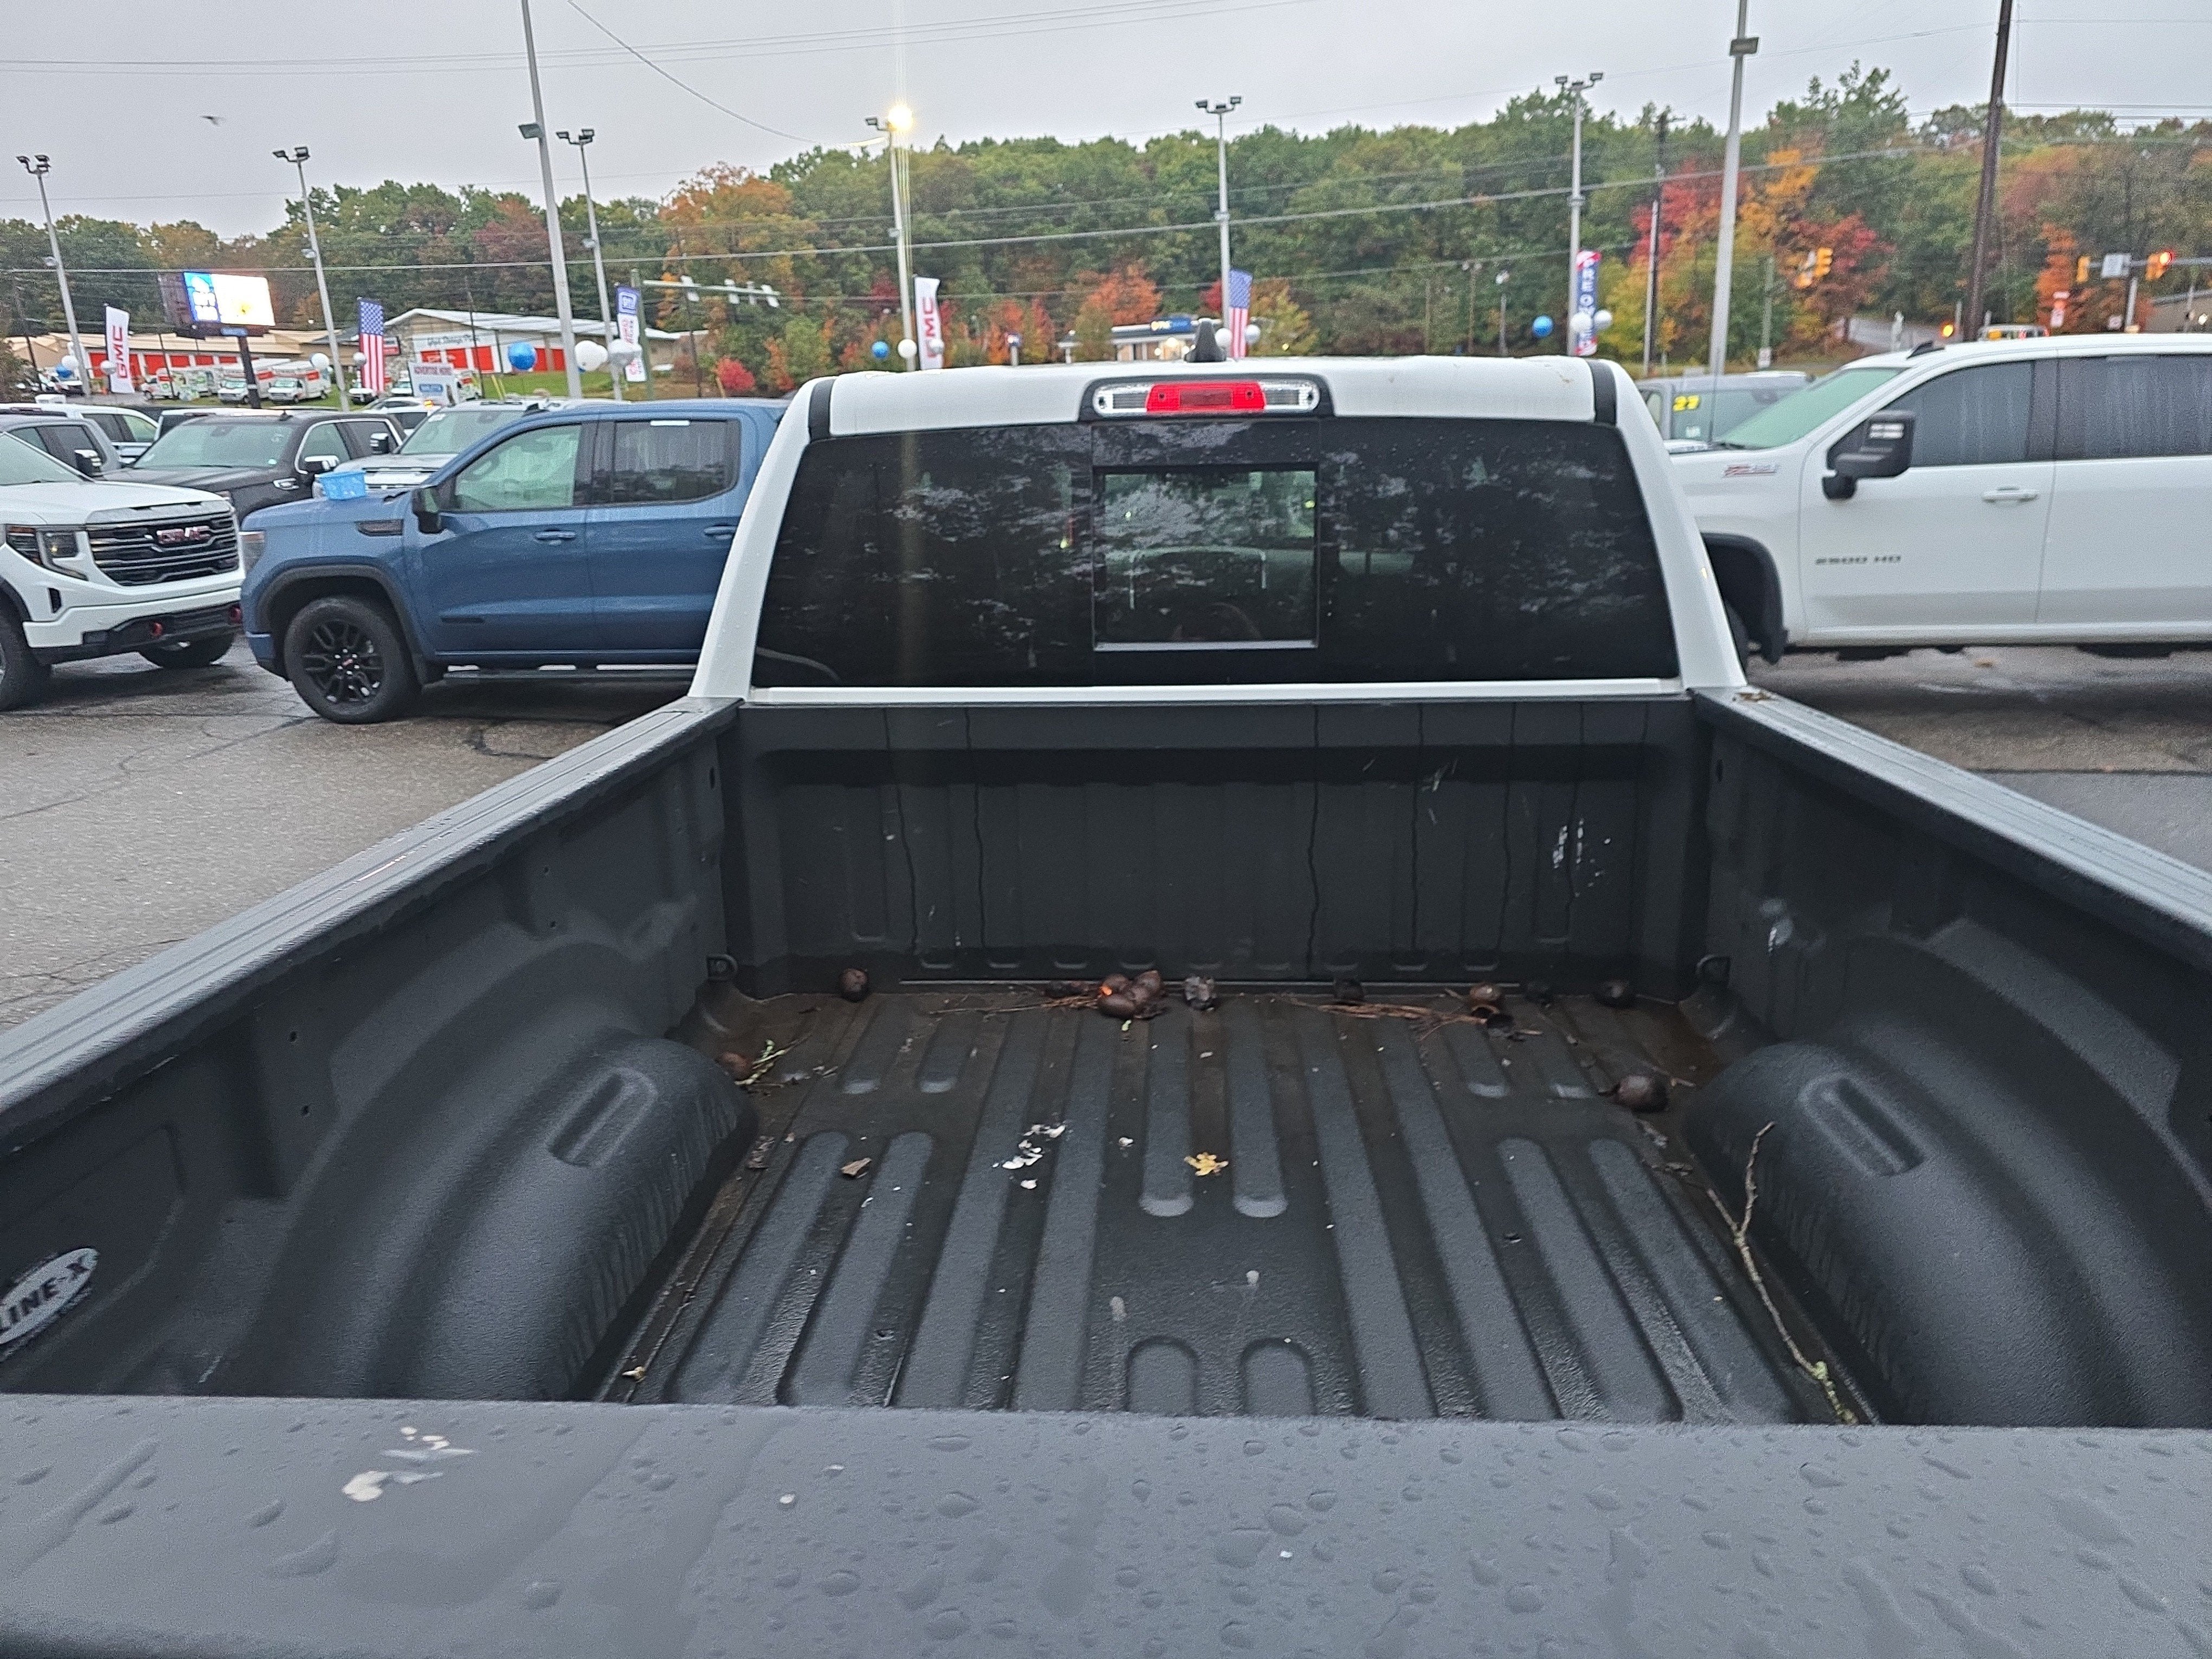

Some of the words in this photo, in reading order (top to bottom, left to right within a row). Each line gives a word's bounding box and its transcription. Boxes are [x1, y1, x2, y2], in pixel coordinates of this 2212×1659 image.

[113, 325, 127, 378] GMC
[156, 525, 211, 544] GMC
[1874, 554, 1901, 563] HD
